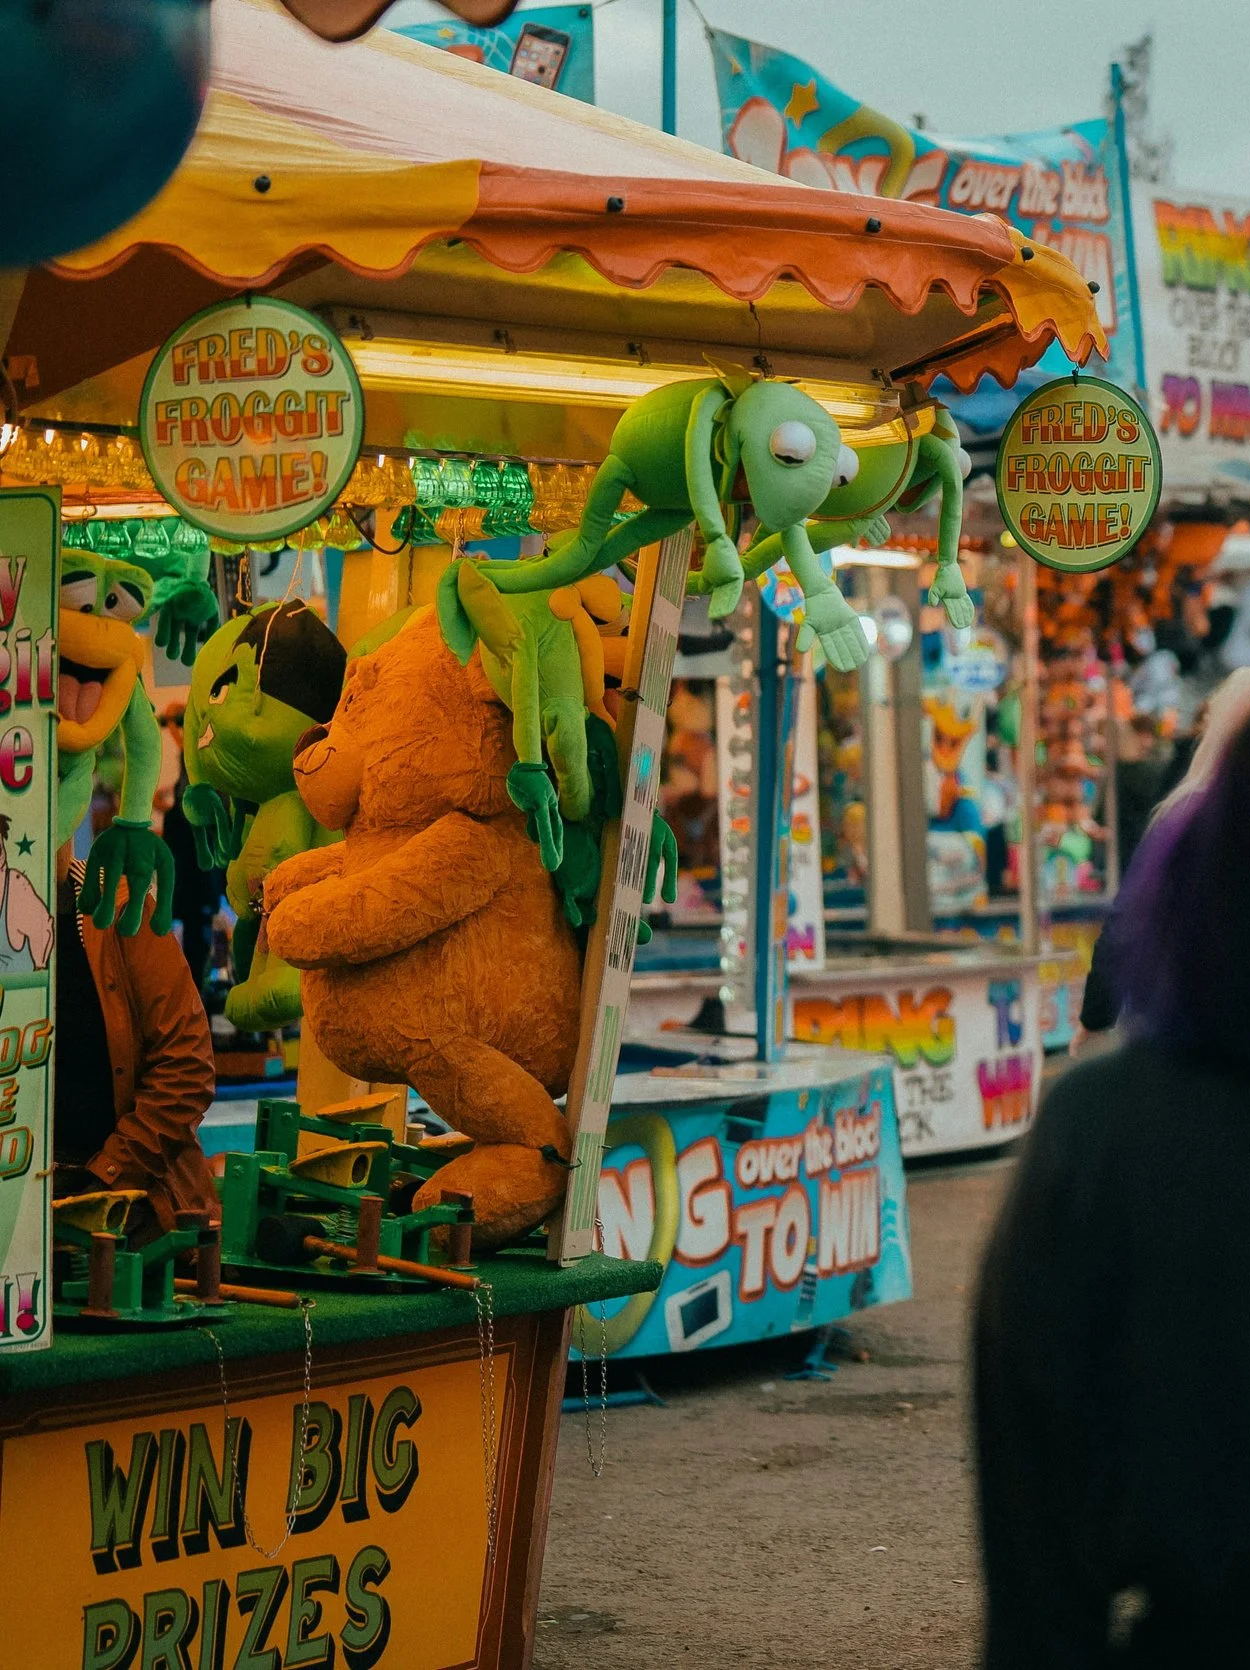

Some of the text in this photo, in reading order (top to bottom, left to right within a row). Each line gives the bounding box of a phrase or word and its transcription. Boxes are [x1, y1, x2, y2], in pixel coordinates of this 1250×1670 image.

[172, 327, 334, 386] FRED'S
[155, 390, 351, 448] FROGGIT
[1021, 401, 1140, 444] FRED'S
[175, 452, 329, 516] GAME!
[1007, 451, 1152, 496] FROGGIT
[1019, 502, 1133, 550] GAME!
[736, 1137, 802, 1191] over
[732, 1164, 881, 1304] TO WIN
[84, 1384, 423, 1575] WIN BIG
[82, 1544, 391, 1670] PRIZES
